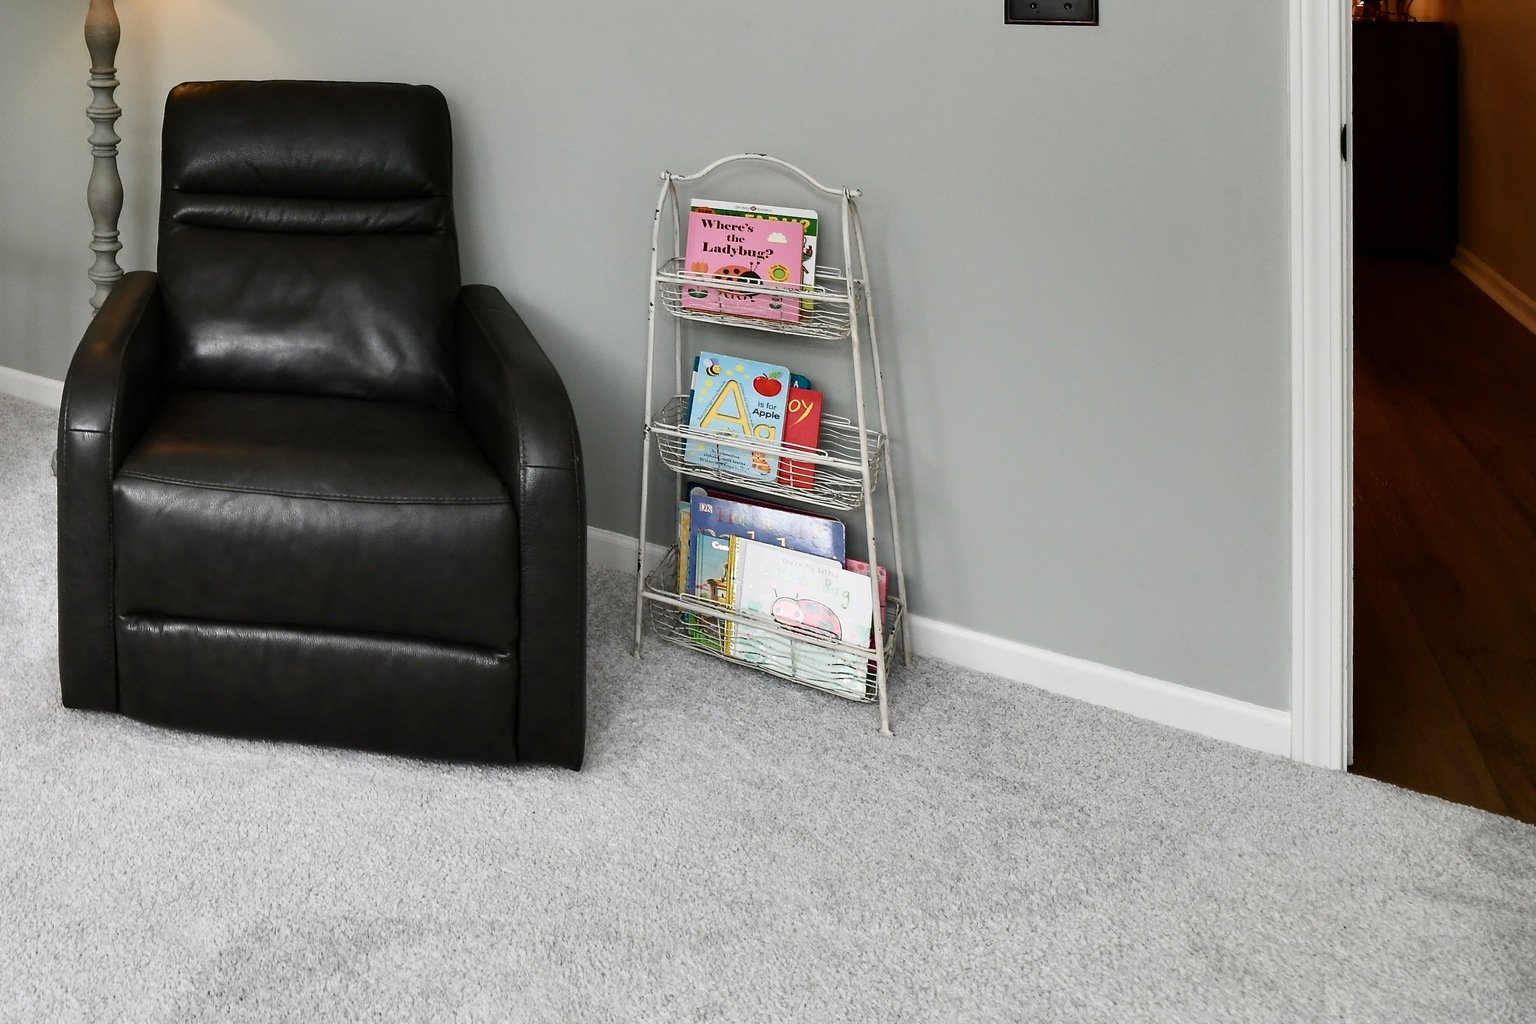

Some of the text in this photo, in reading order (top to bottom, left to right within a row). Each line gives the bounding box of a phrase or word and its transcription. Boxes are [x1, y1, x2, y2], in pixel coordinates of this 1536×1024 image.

[701, 219, 754, 233] Where's
[727, 234, 745, 243] the
[702, 242, 774, 261] Ladybug?
[766, 402, 777, 411] for
[752, 408, 780, 420] Apple
[700, 503, 713, 514] DK
